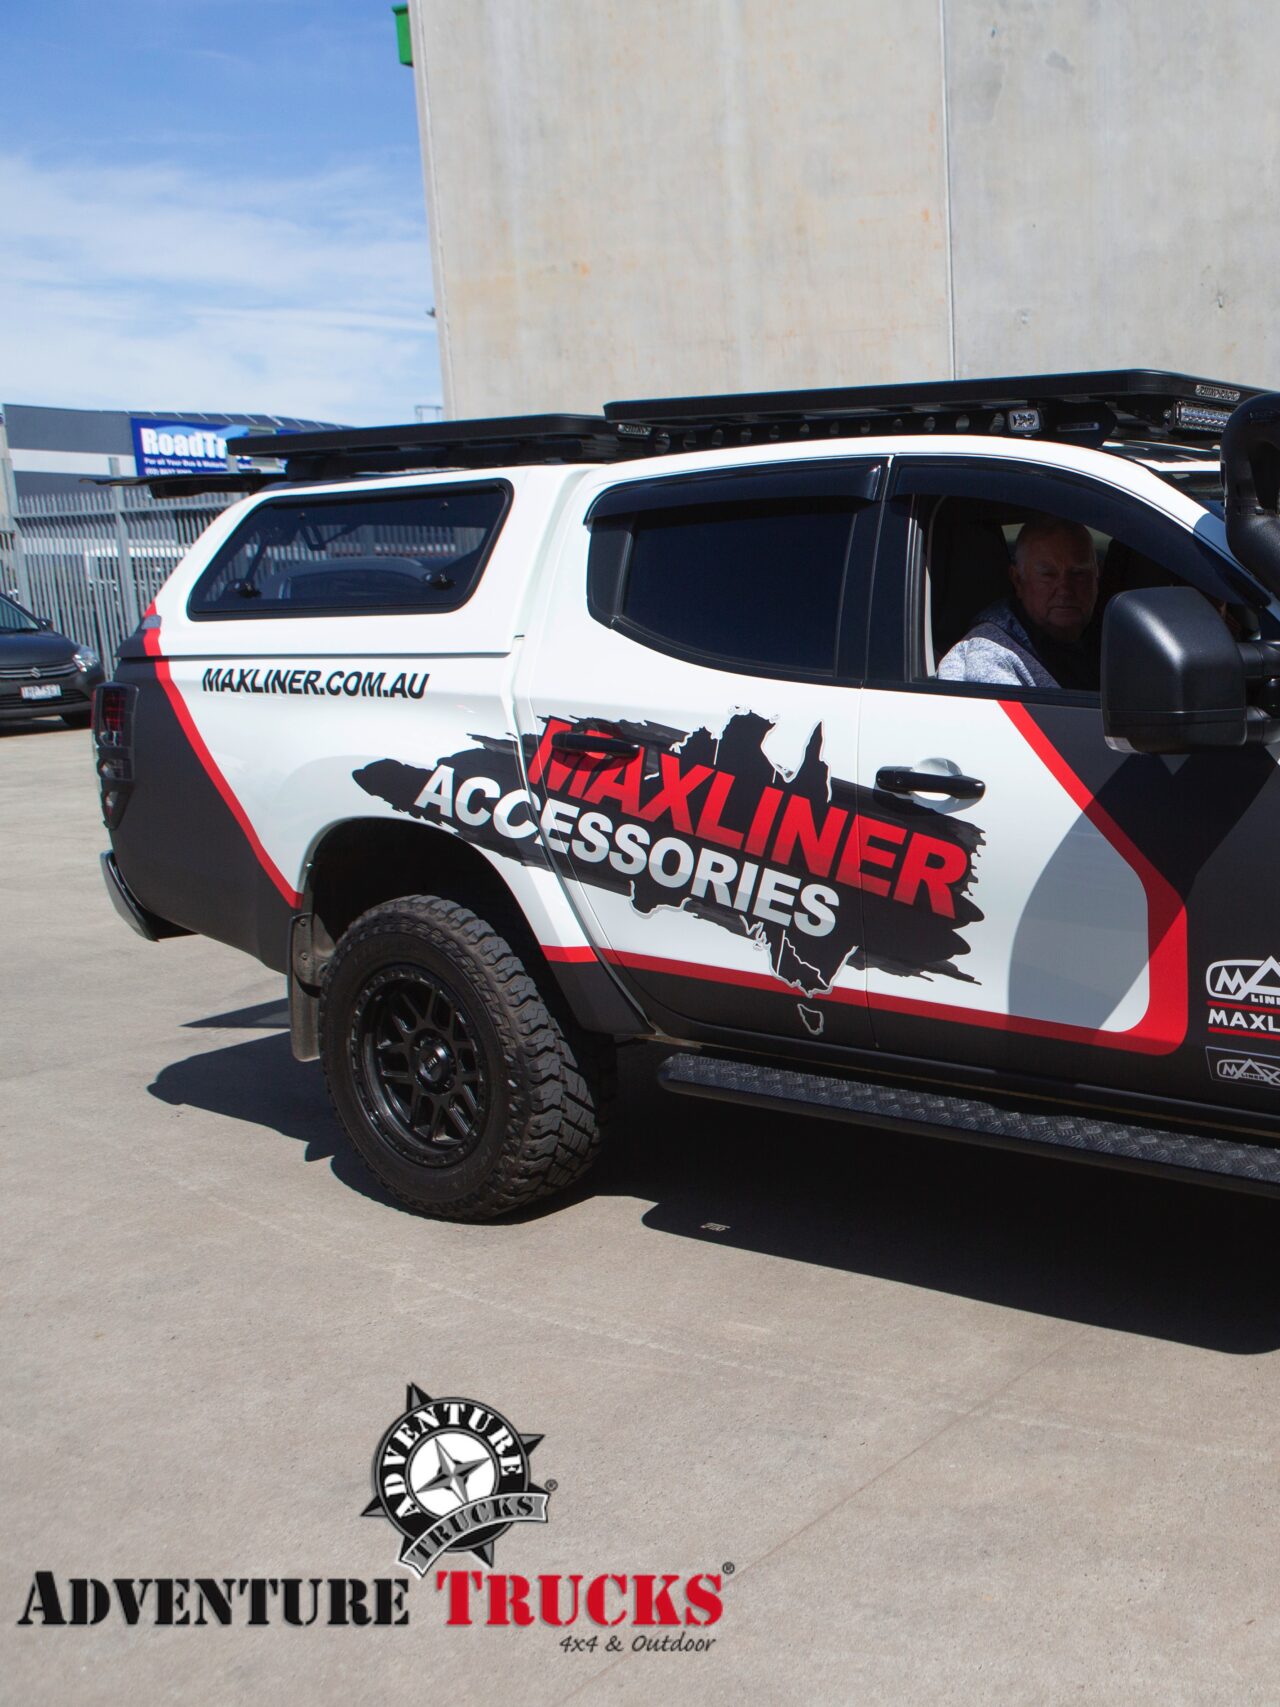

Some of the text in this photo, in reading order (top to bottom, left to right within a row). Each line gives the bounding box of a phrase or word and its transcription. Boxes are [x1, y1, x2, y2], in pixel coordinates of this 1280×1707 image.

[140, 427, 227, 459] RoadTr
[202, 668, 430, 699] MAXLINER.COM.AU
[413, 765, 840, 937] ACCESSORIES
[528, 718, 970, 919] MAXLINER
